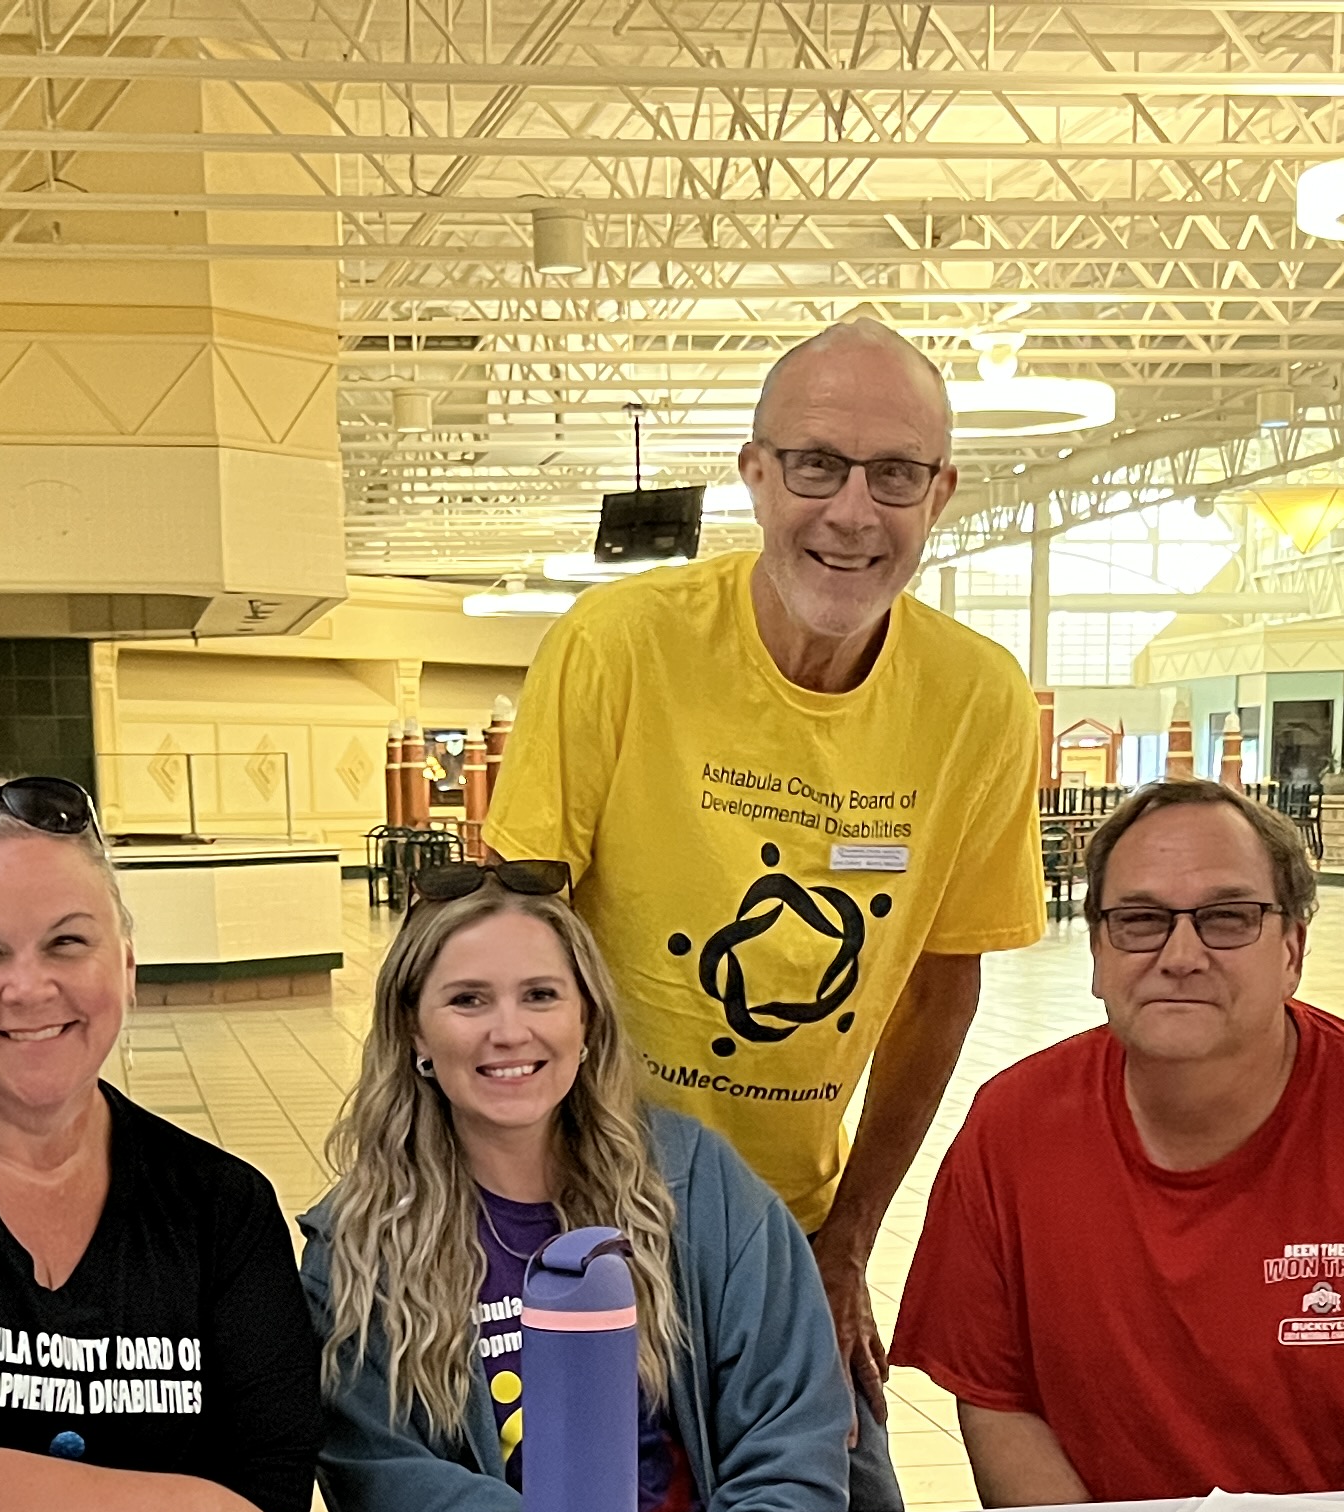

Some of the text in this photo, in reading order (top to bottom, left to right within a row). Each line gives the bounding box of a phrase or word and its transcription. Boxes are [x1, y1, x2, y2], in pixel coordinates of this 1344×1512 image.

[702, 763, 917, 813] Ashtabula County Board of
[701, 790, 912, 839] Developmental Disabilities
[1263, 1257, 1319, 1284] WON
[1284, 1243, 1319, 1258] BEEN
[36, 1331, 110, 1373] COUNTY
